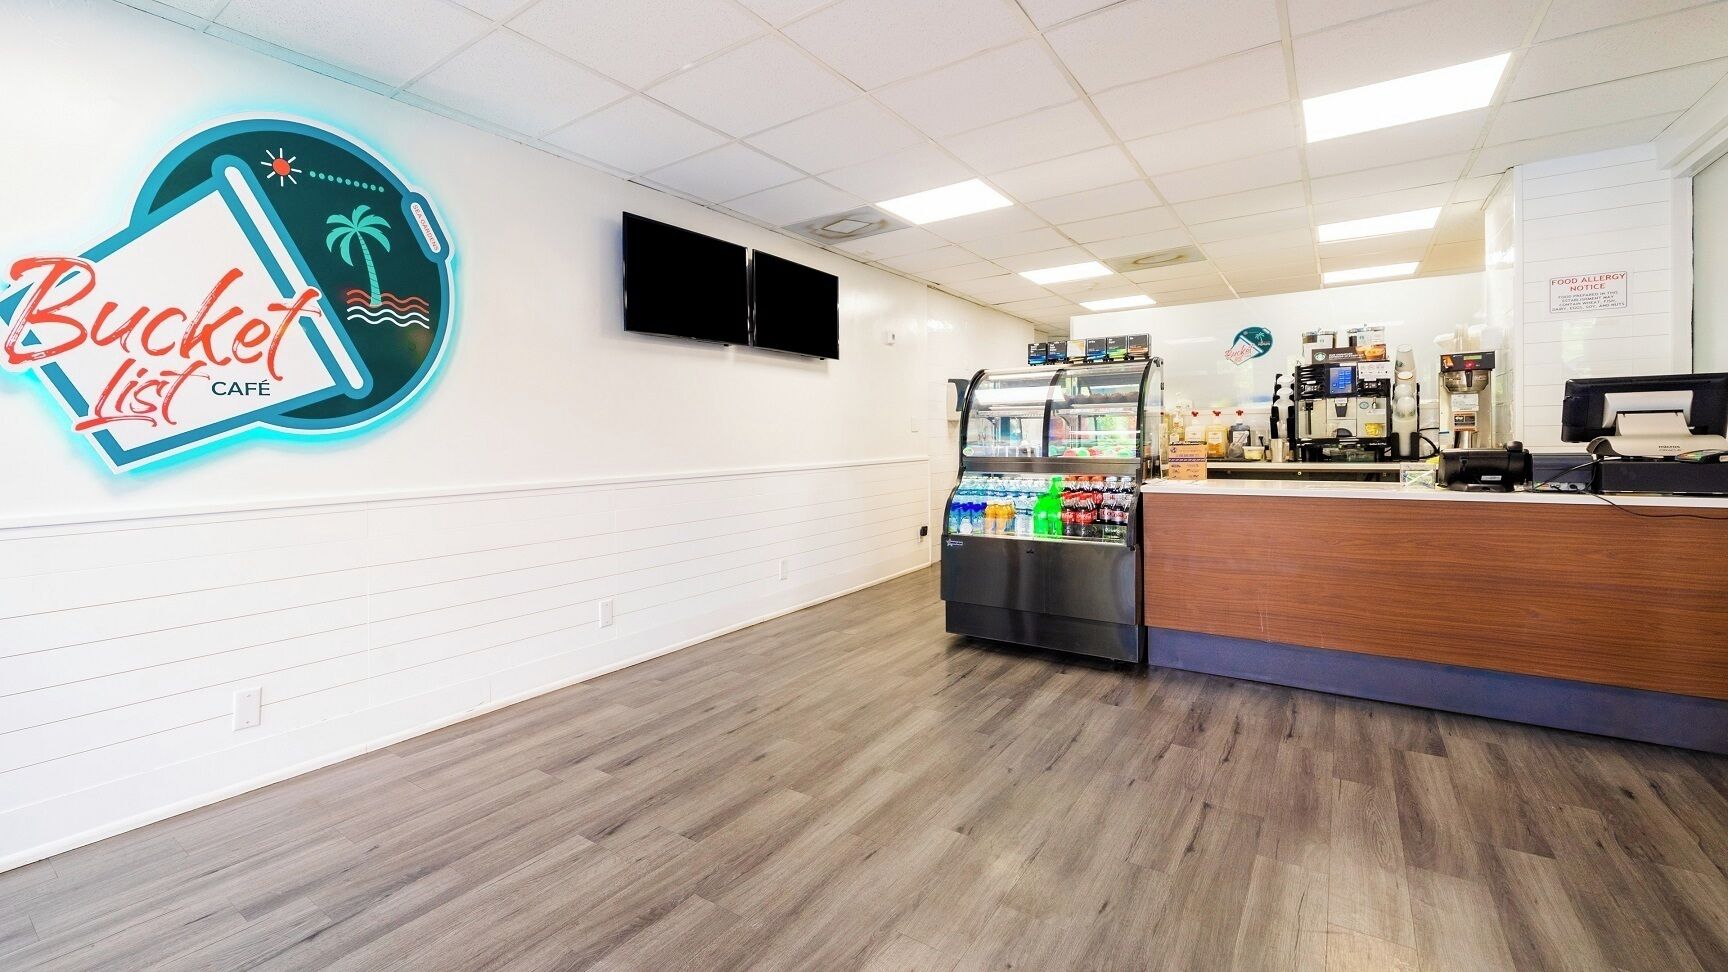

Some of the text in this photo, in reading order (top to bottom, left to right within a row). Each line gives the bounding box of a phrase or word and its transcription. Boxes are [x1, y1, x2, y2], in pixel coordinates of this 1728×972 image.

[413, 204, 439, 251] SEA GARDENS
[1570, 282, 1606, 291] NOTICE
[1581, 273, 1626, 283] ALLERGY
[5, 257, 321, 381] Bucket
[75, 358, 271, 431] List CAFÉ
